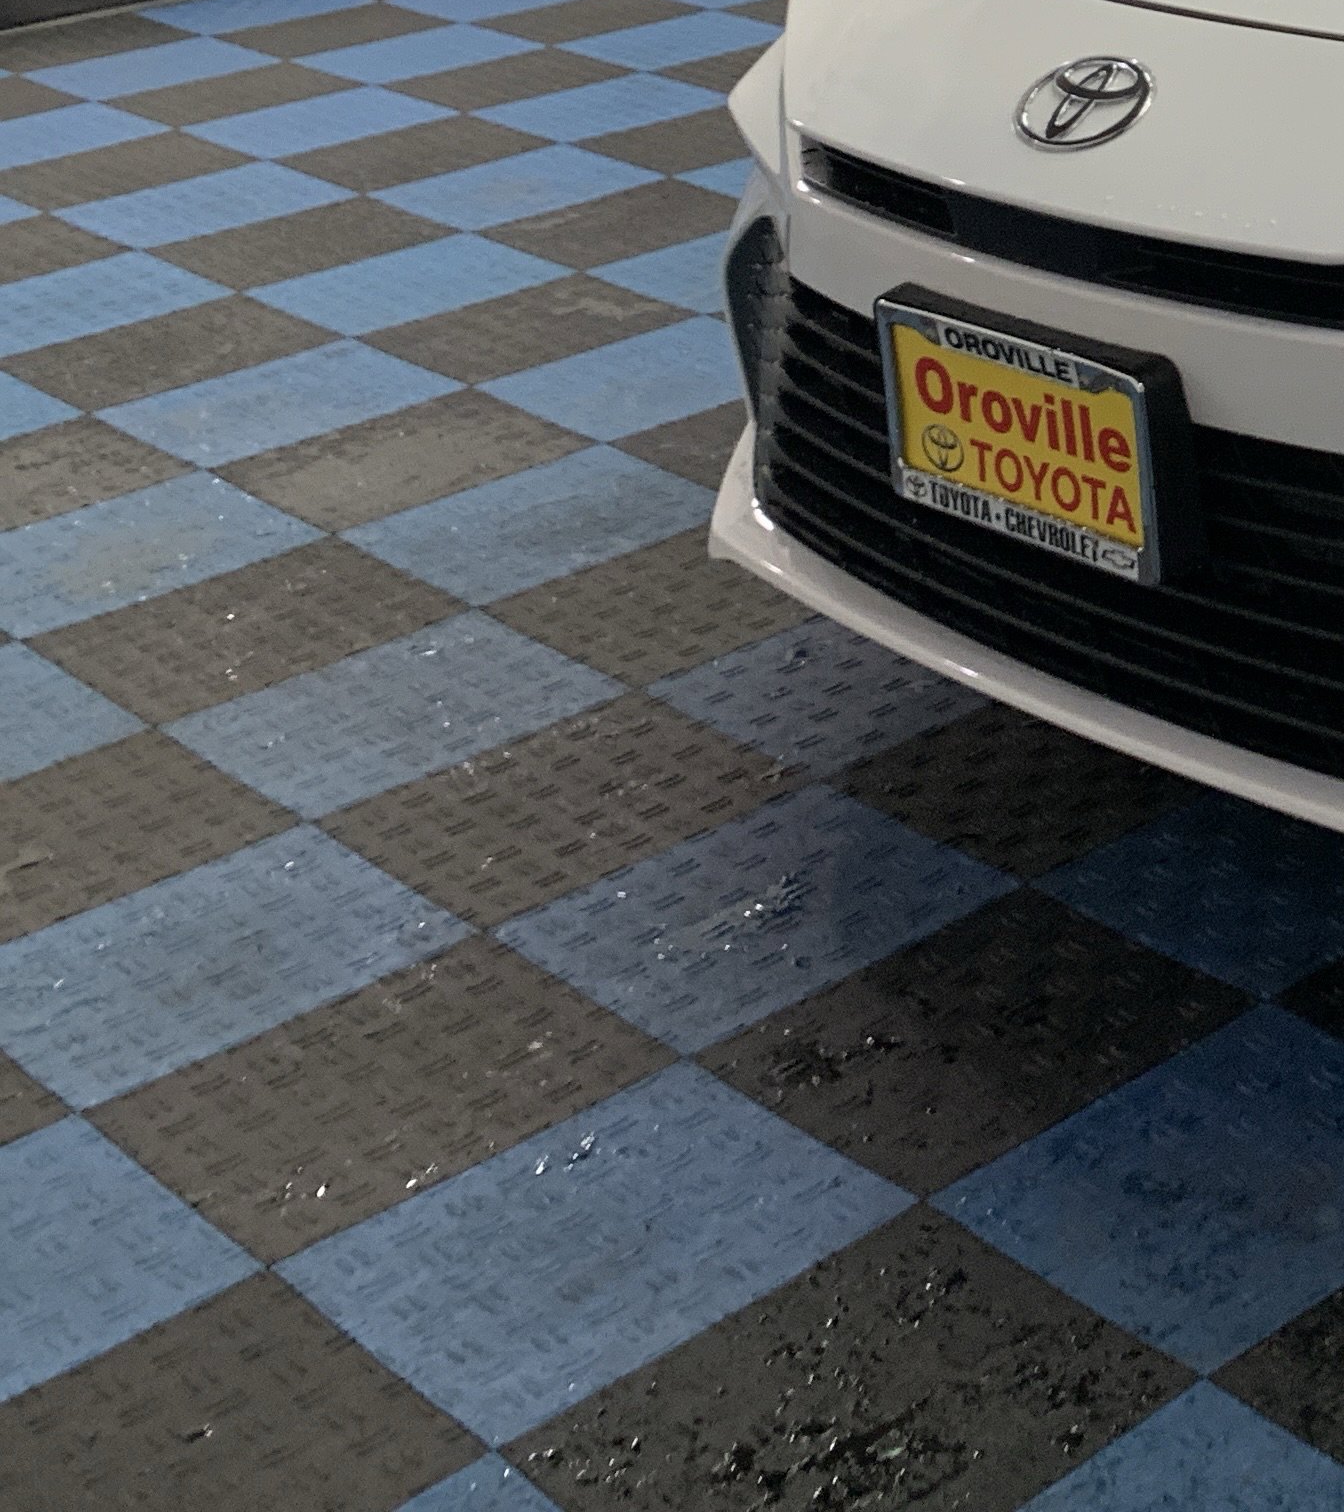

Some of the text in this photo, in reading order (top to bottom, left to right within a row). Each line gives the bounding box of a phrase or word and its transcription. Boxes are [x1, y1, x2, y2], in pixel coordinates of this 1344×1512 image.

[944, 327, 1072, 383] OROVILLE
[915, 355, 1132, 473] Oroville
[969, 439, 1137, 533] TOYOTA
